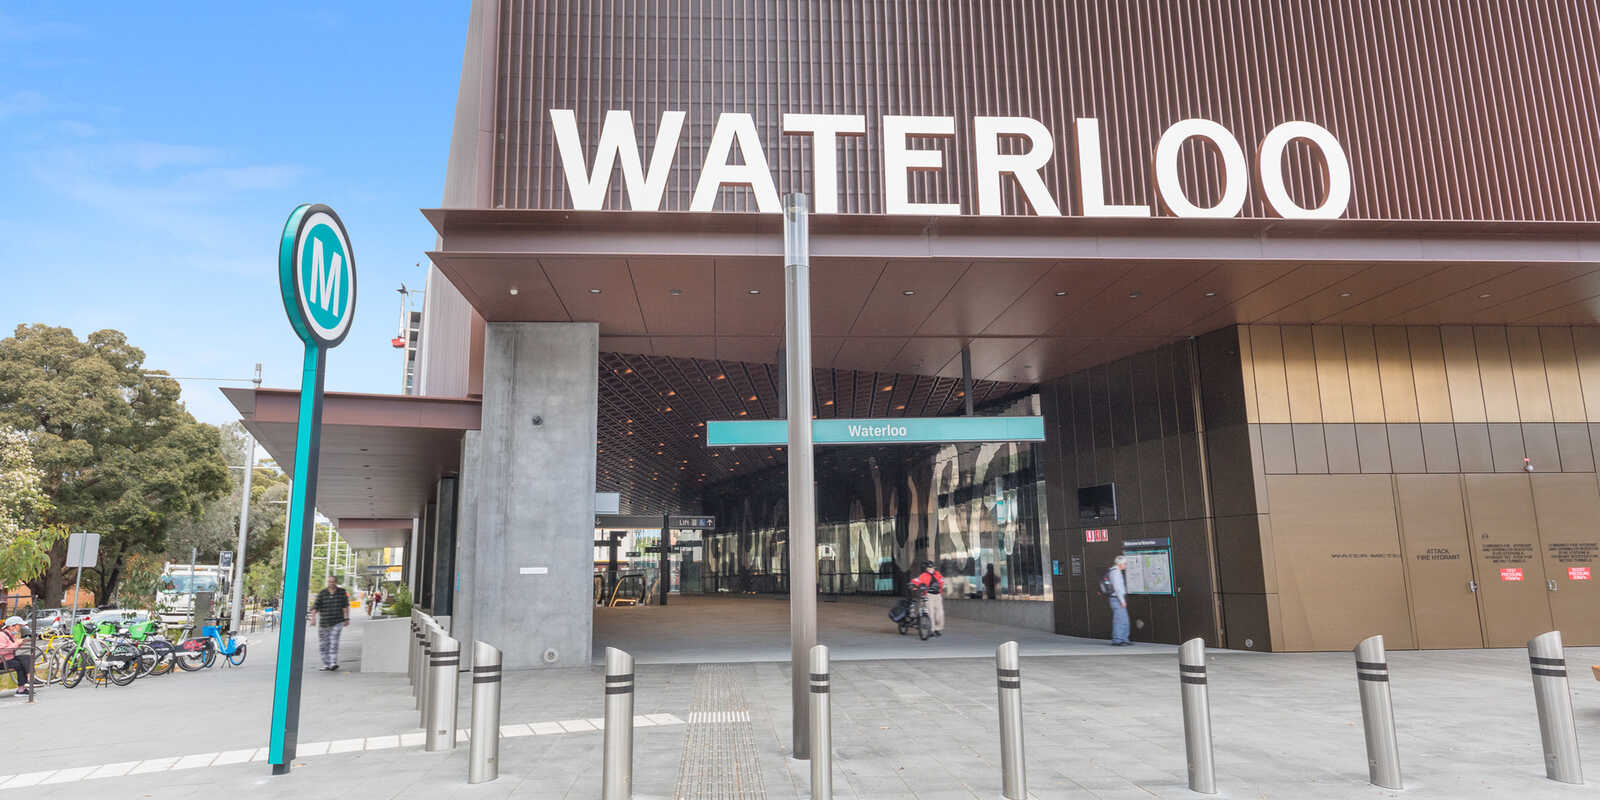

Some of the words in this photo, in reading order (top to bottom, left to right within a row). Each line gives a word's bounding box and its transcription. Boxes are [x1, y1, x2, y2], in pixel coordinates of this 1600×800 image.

[550, 108, 1352, 220] WATERLOO
[310, 236, 342, 318] M
[848, 423, 907, 437] Waterloo
